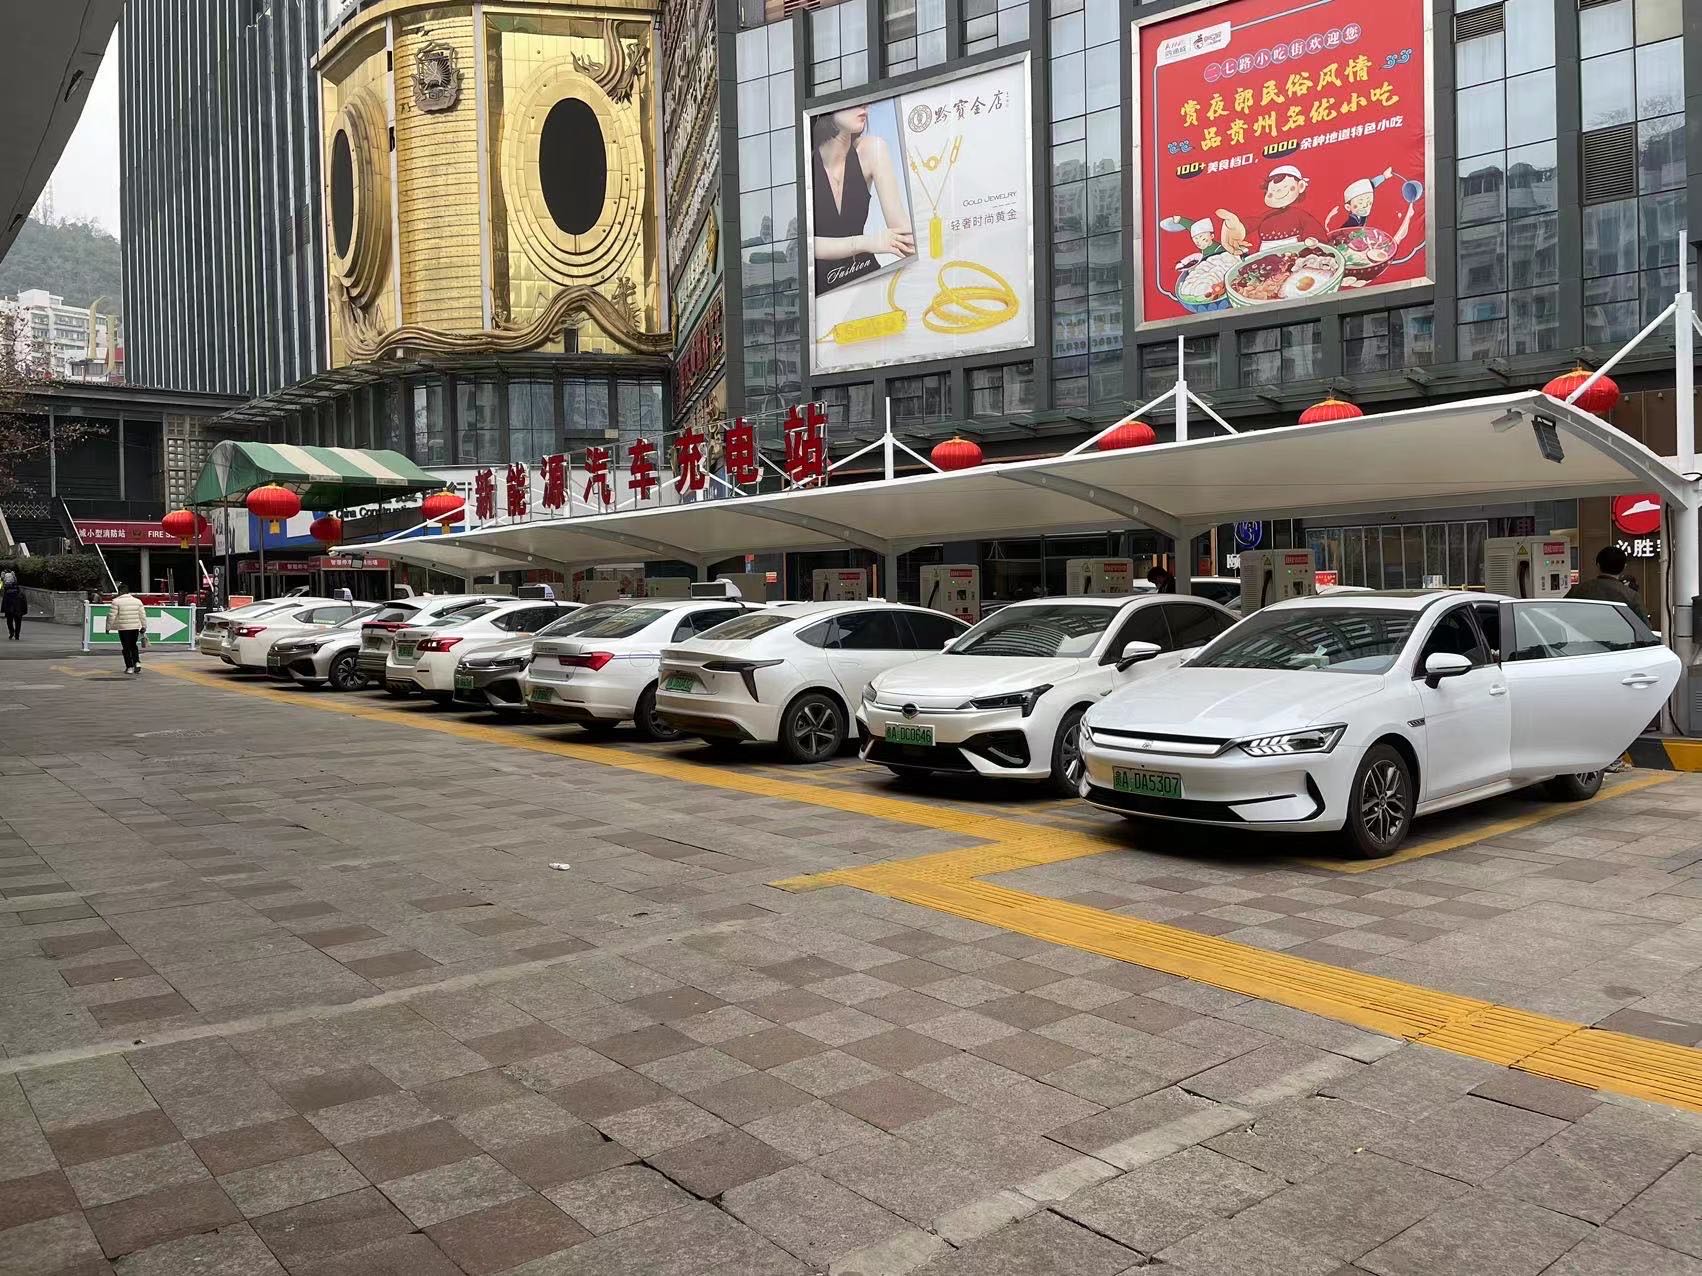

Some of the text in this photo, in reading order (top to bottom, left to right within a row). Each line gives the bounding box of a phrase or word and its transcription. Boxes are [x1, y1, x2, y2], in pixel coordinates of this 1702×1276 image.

[1205, 24, 1361, 81] 二七路小吃街欢迎您
[1180, 55, 1372, 127] 赏夜郎民俗风情
[1200, 81, 1400, 152] 品贵州名优小吃
[951, 208, 1017, 231] 轻奢时尚黄金
[826, 259, 871, 284] Fashion
[148, 530, 164, 538] FIRE
